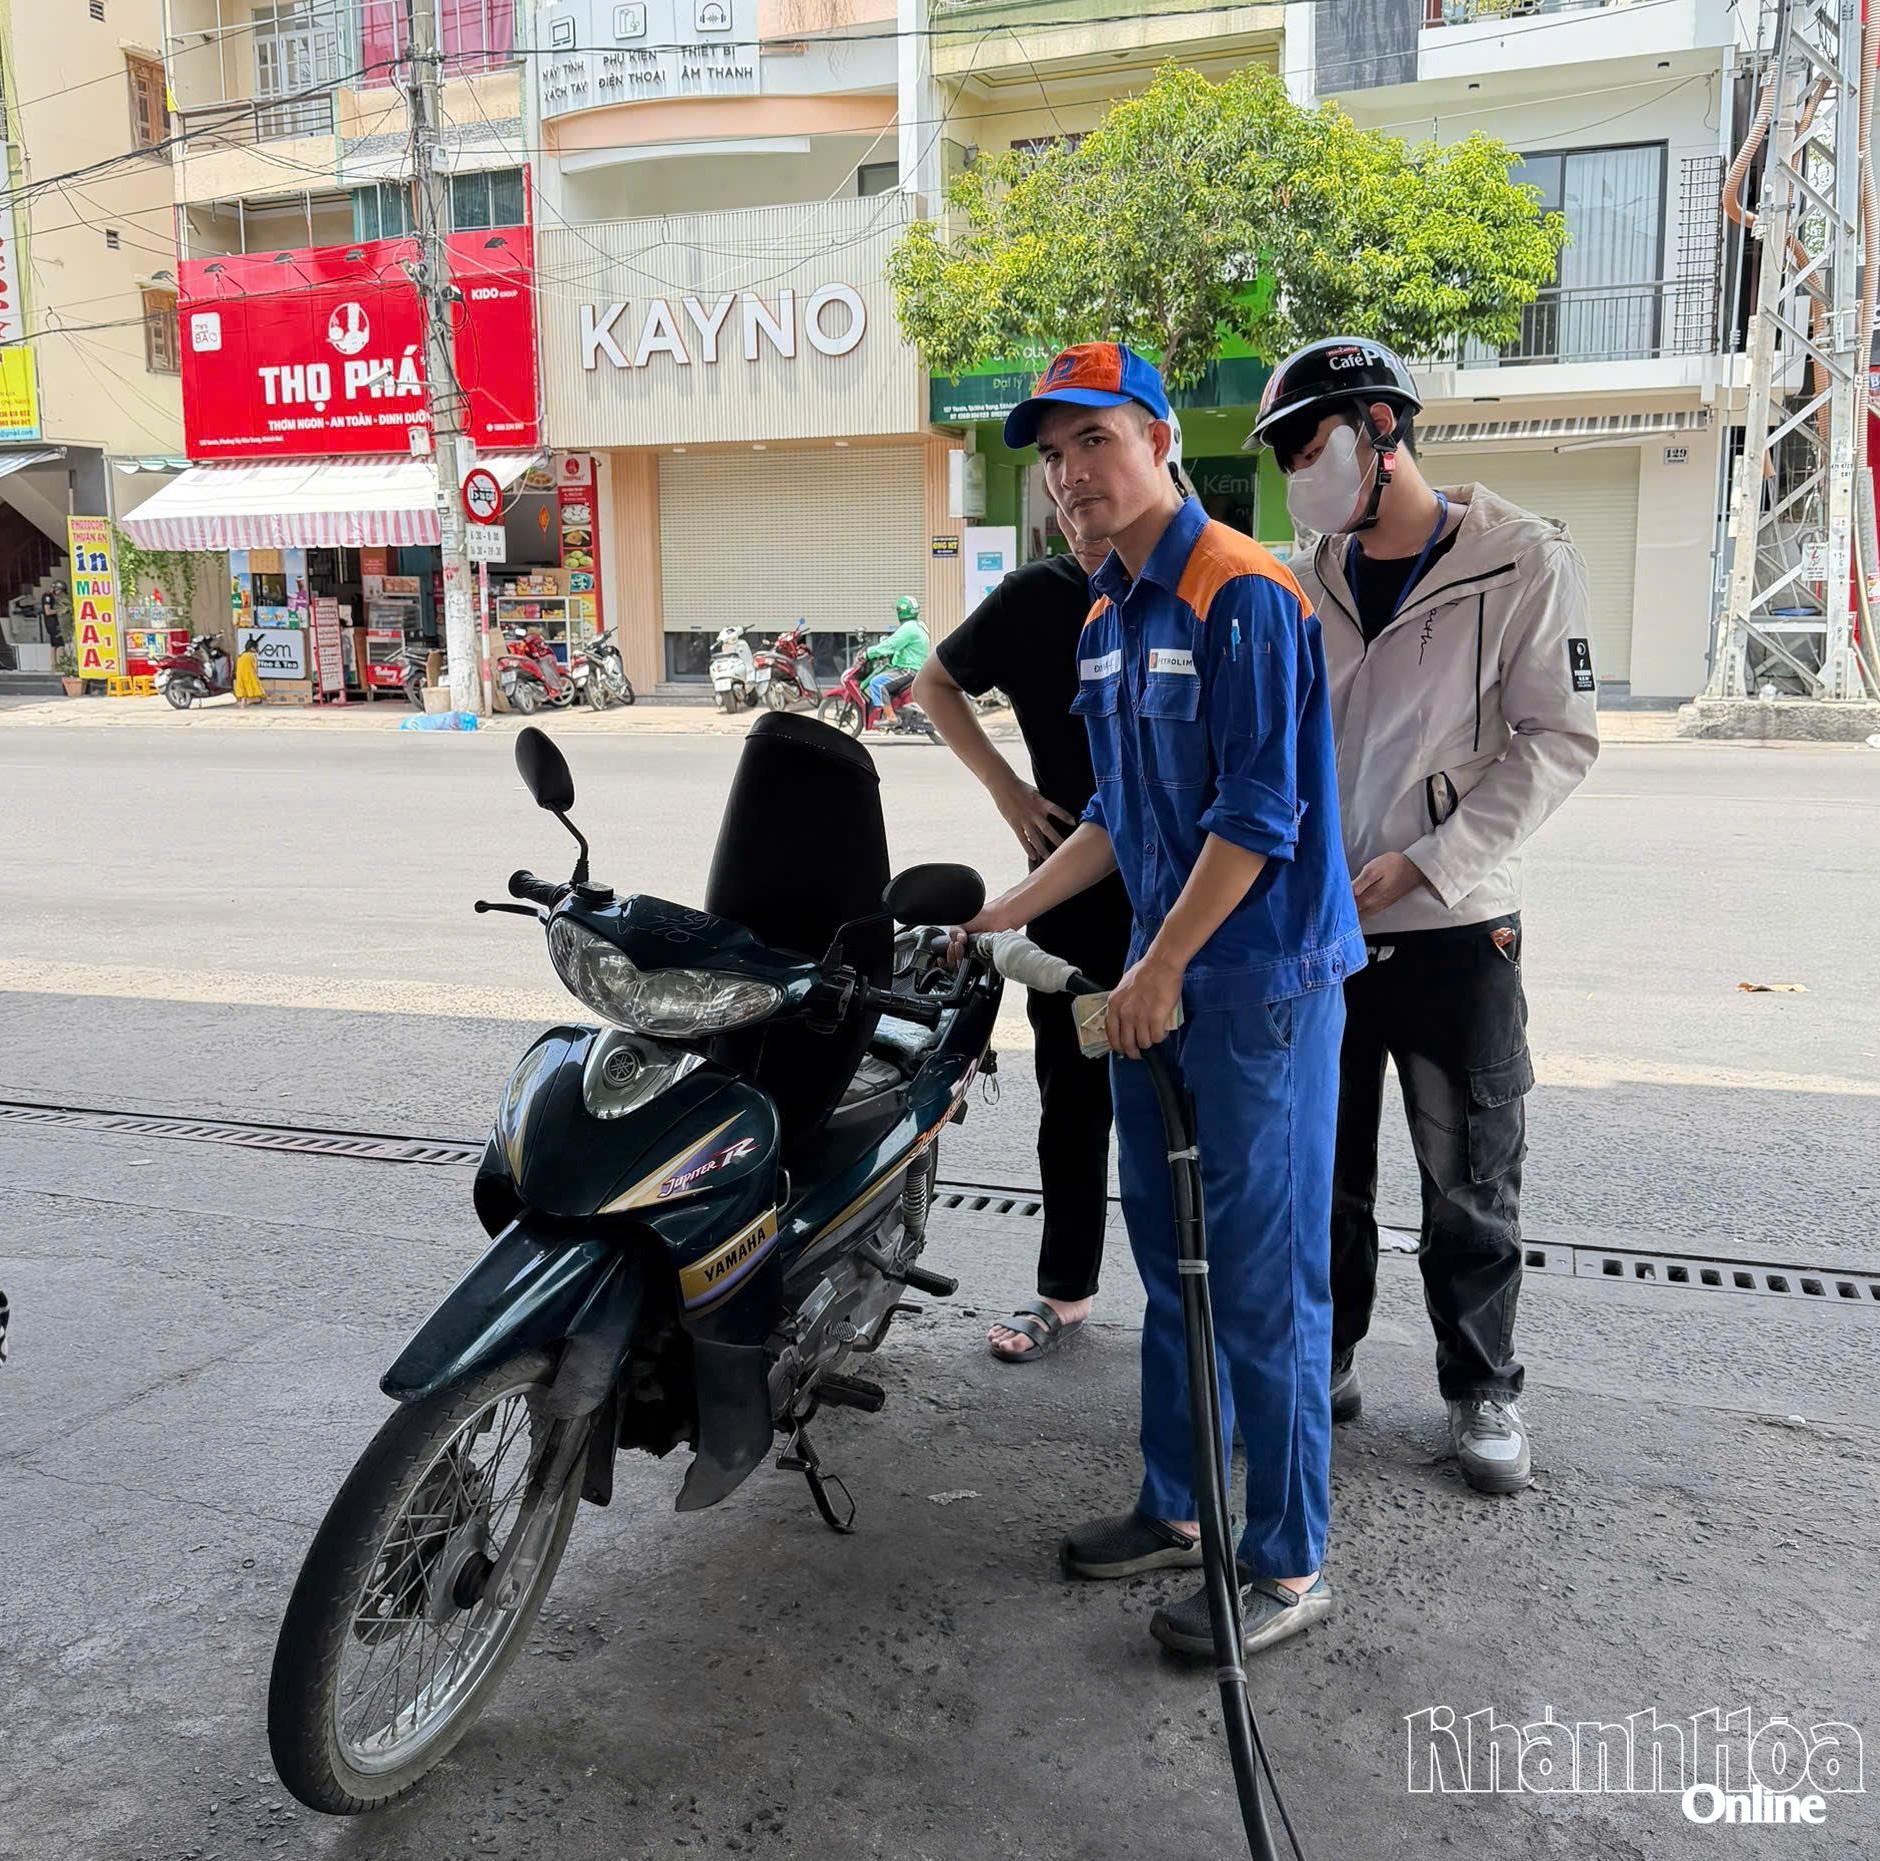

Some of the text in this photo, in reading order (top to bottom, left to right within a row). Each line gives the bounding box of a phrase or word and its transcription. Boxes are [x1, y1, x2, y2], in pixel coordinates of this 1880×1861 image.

[602, 50, 657, 67] PHỤ KIỆN
[598, 70, 666, 89] ĐIỆN THOẠI
[706, 66, 753, 80] THANH
[570, 81, 588, 94] TAY
[471, 287, 499, 300] KIDO
[579, 281, 868, 370] KAYNO
[1329, 353, 1365, 371] Café
[257, 344, 426, 413] THỌ PHÁ
[297, 416, 325, 429] NGON
[330, 415, 345, 428] AN
[345, 411, 373, 427] TOÀN
[1667, 448, 1688, 458] 129
[75, 545, 109, 572] in
[76, 576, 111, 596] MÀU
[657, 1137, 760, 1199] JUPITER R
[703, 1227, 766, 1282] YAMAHA
